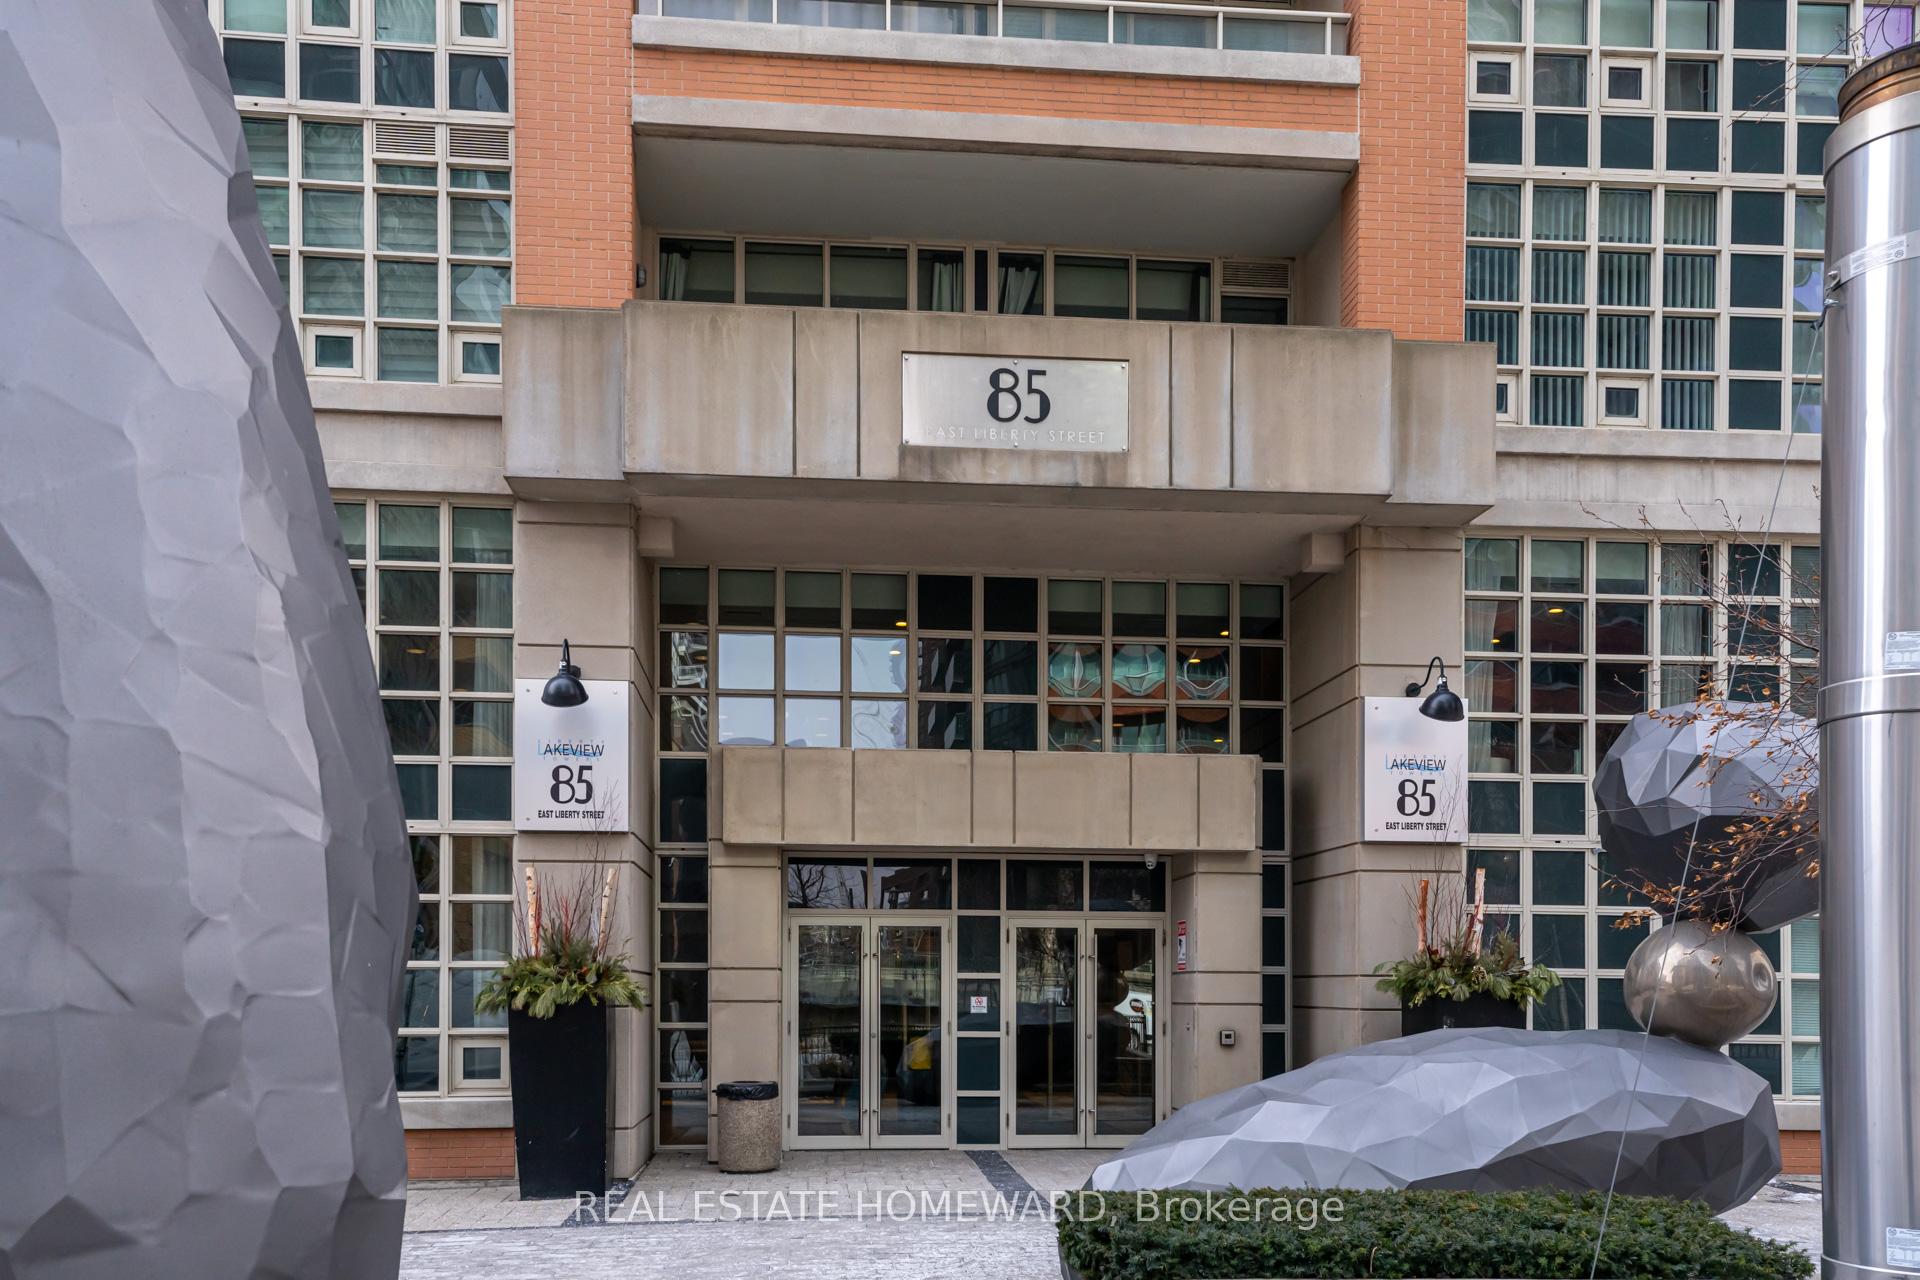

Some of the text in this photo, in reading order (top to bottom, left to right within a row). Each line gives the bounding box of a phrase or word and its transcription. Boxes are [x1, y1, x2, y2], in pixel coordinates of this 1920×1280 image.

[987, 367, 1050, 424] 85
[1049, 430, 1105, 444] STREET
[537, 743, 605, 757] LAKEVIEW
[1385, 757, 1447, 771] LAKEVIEW
[551, 765, 593, 805] 85
[1397, 779, 1436, 817] 85
[538, 809, 605, 819] EAST LIBERTY STREET
[1385, 821, 1447, 831] EAST LIBERTY STREET
